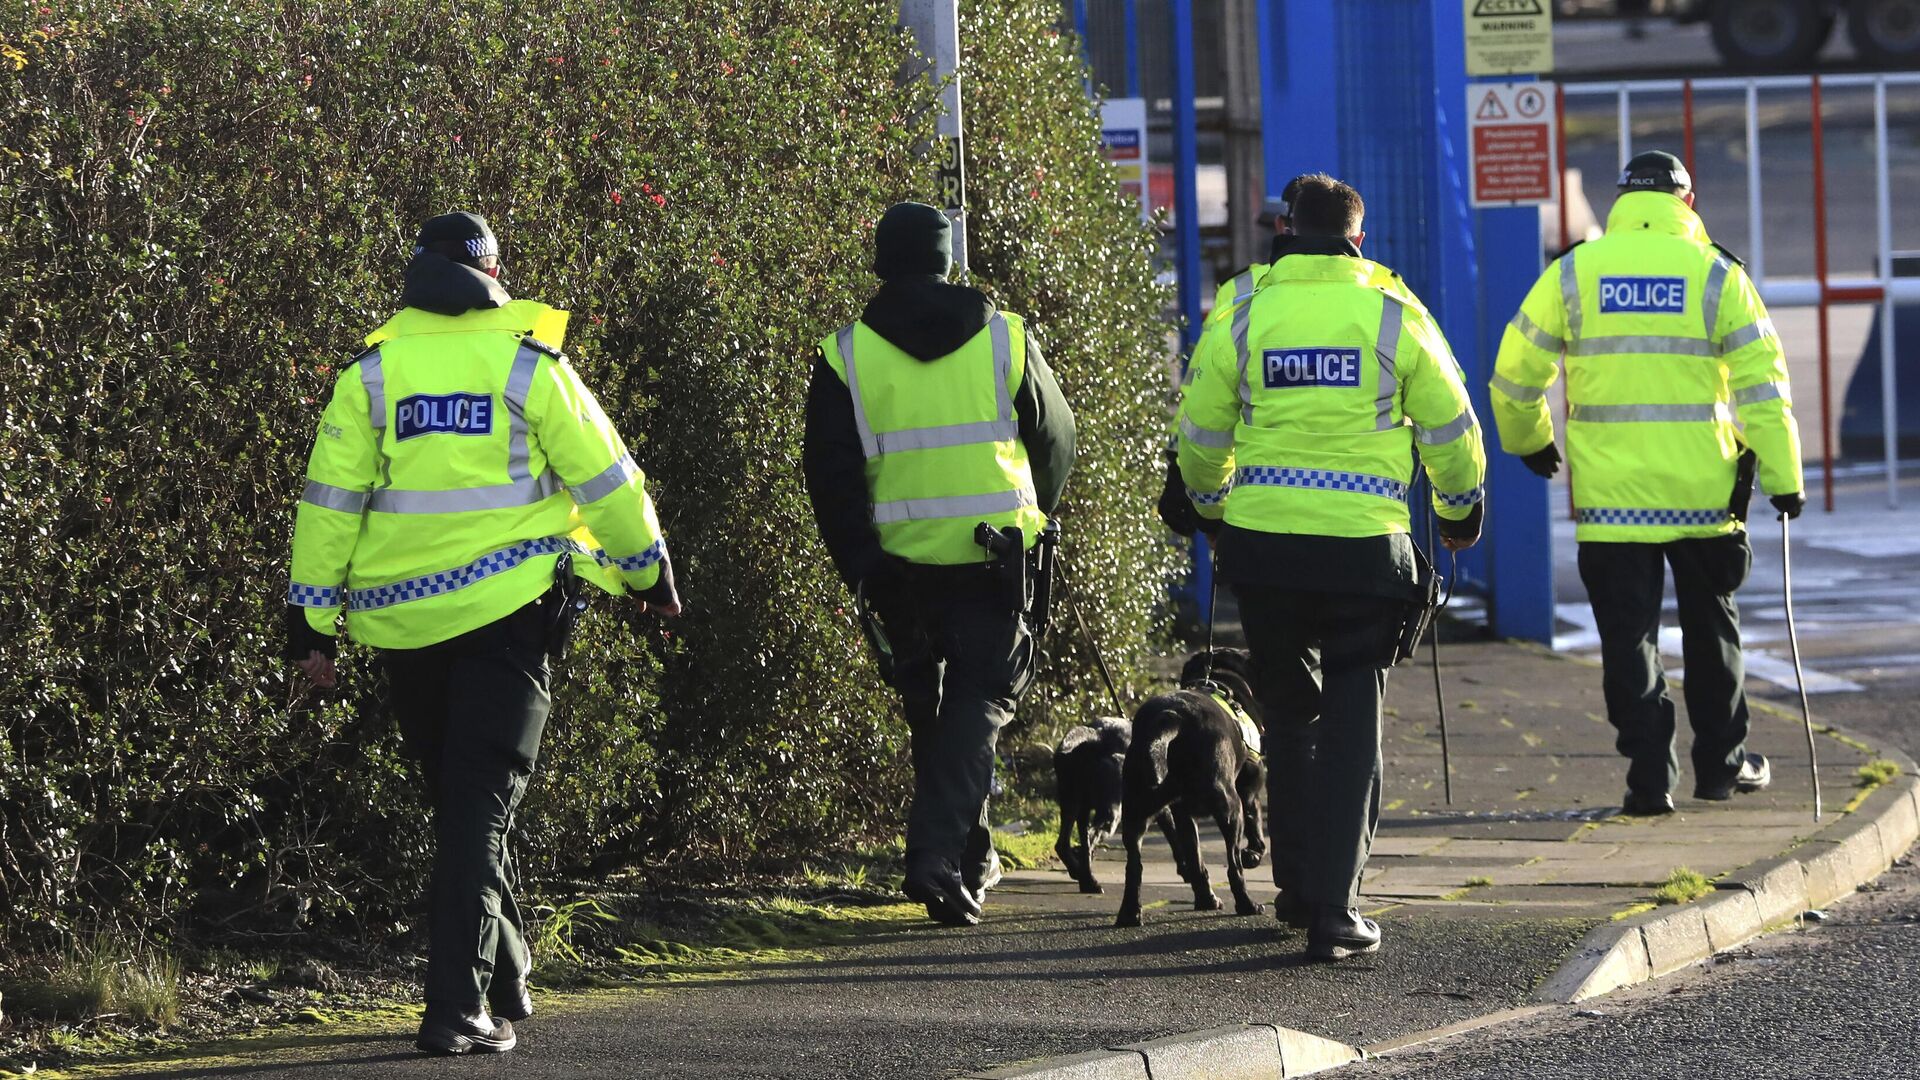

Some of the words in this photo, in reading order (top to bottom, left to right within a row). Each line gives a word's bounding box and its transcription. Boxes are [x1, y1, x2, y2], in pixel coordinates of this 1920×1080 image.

[1483, 0, 1529, 10] CCTV
[1481, 20, 1536, 32] WARNING
[1601, 282, 1683, 307] POLICE
[1266, 353, 1356, 382] POLICE
[398, 398, 487, 434] POLICE
